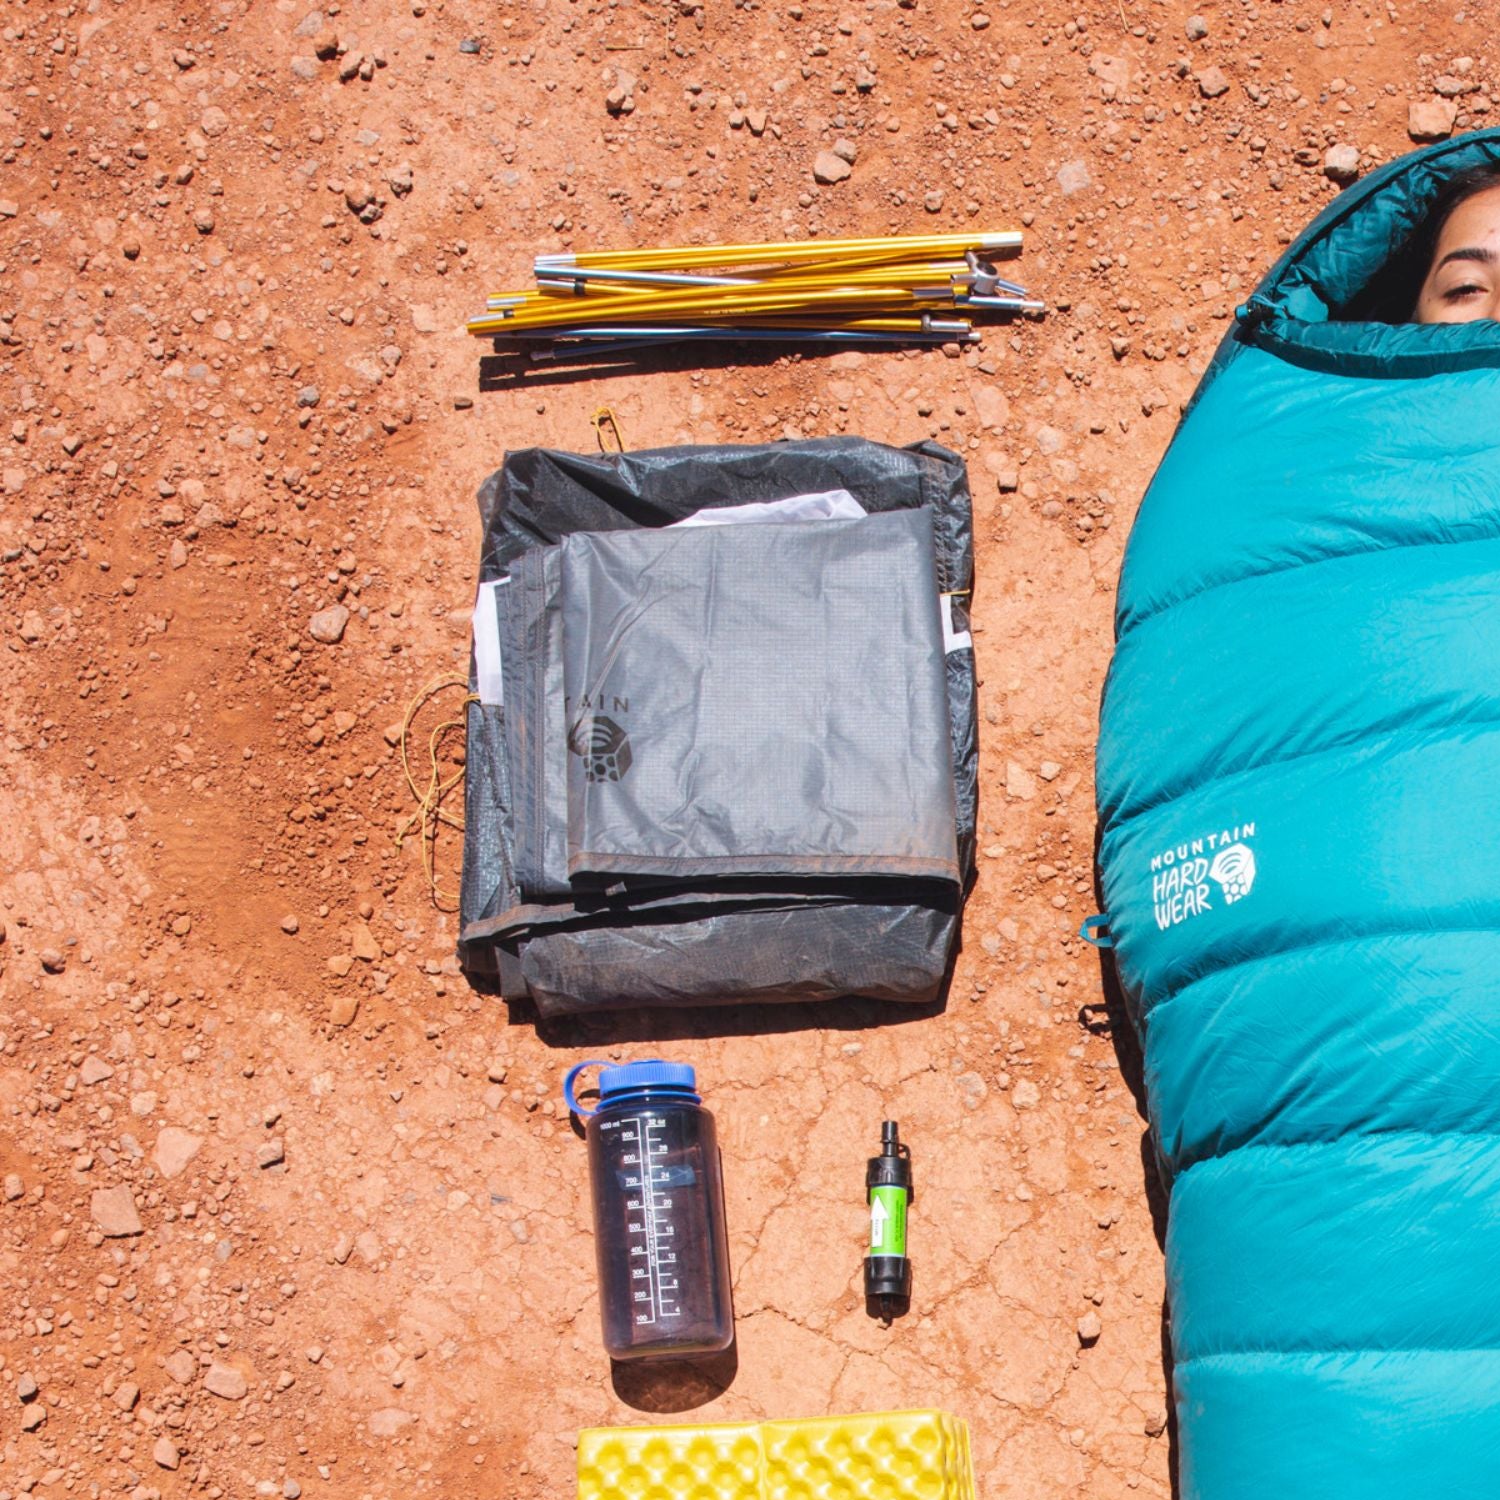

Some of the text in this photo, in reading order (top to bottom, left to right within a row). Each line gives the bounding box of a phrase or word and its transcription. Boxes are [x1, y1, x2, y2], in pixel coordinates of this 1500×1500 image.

[1151, 822, 1256, 872] MOUNTAIN
[1152, 857, 1209, 903] HARD
[1154, 883, 1213, 931] WEAR
[630, 1245, 643, 1253] 400
[636, 1314, 648, 1322] 100
